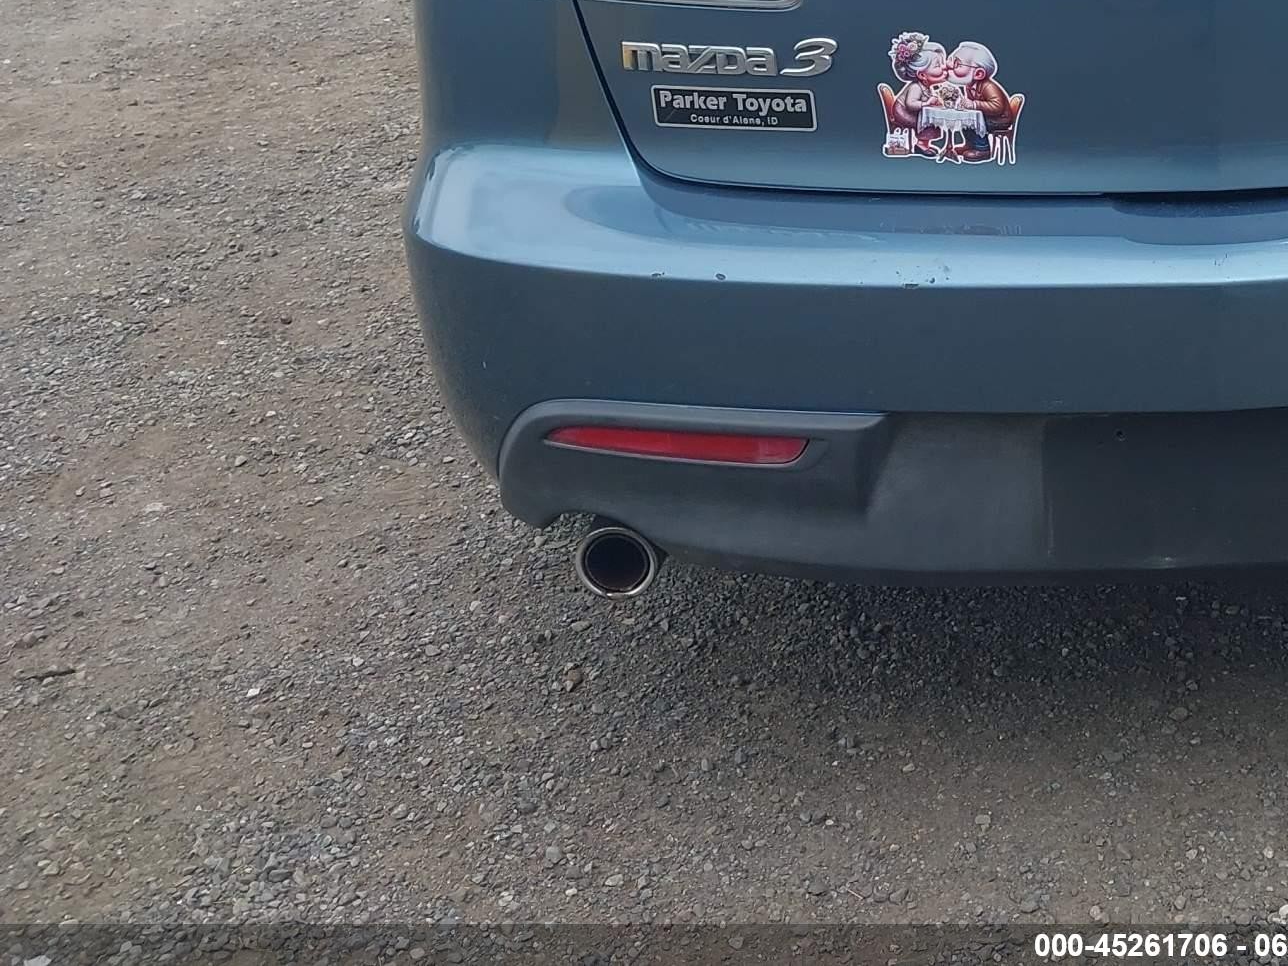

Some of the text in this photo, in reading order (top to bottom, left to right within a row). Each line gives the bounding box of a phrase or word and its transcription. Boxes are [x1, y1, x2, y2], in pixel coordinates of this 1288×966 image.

[780, 37, 838, 77] 3
[659, 90, 807, 116] Parker Toyota
[690, 114, 720, 124] Coeur
[767, 116, 779, 126] ID
